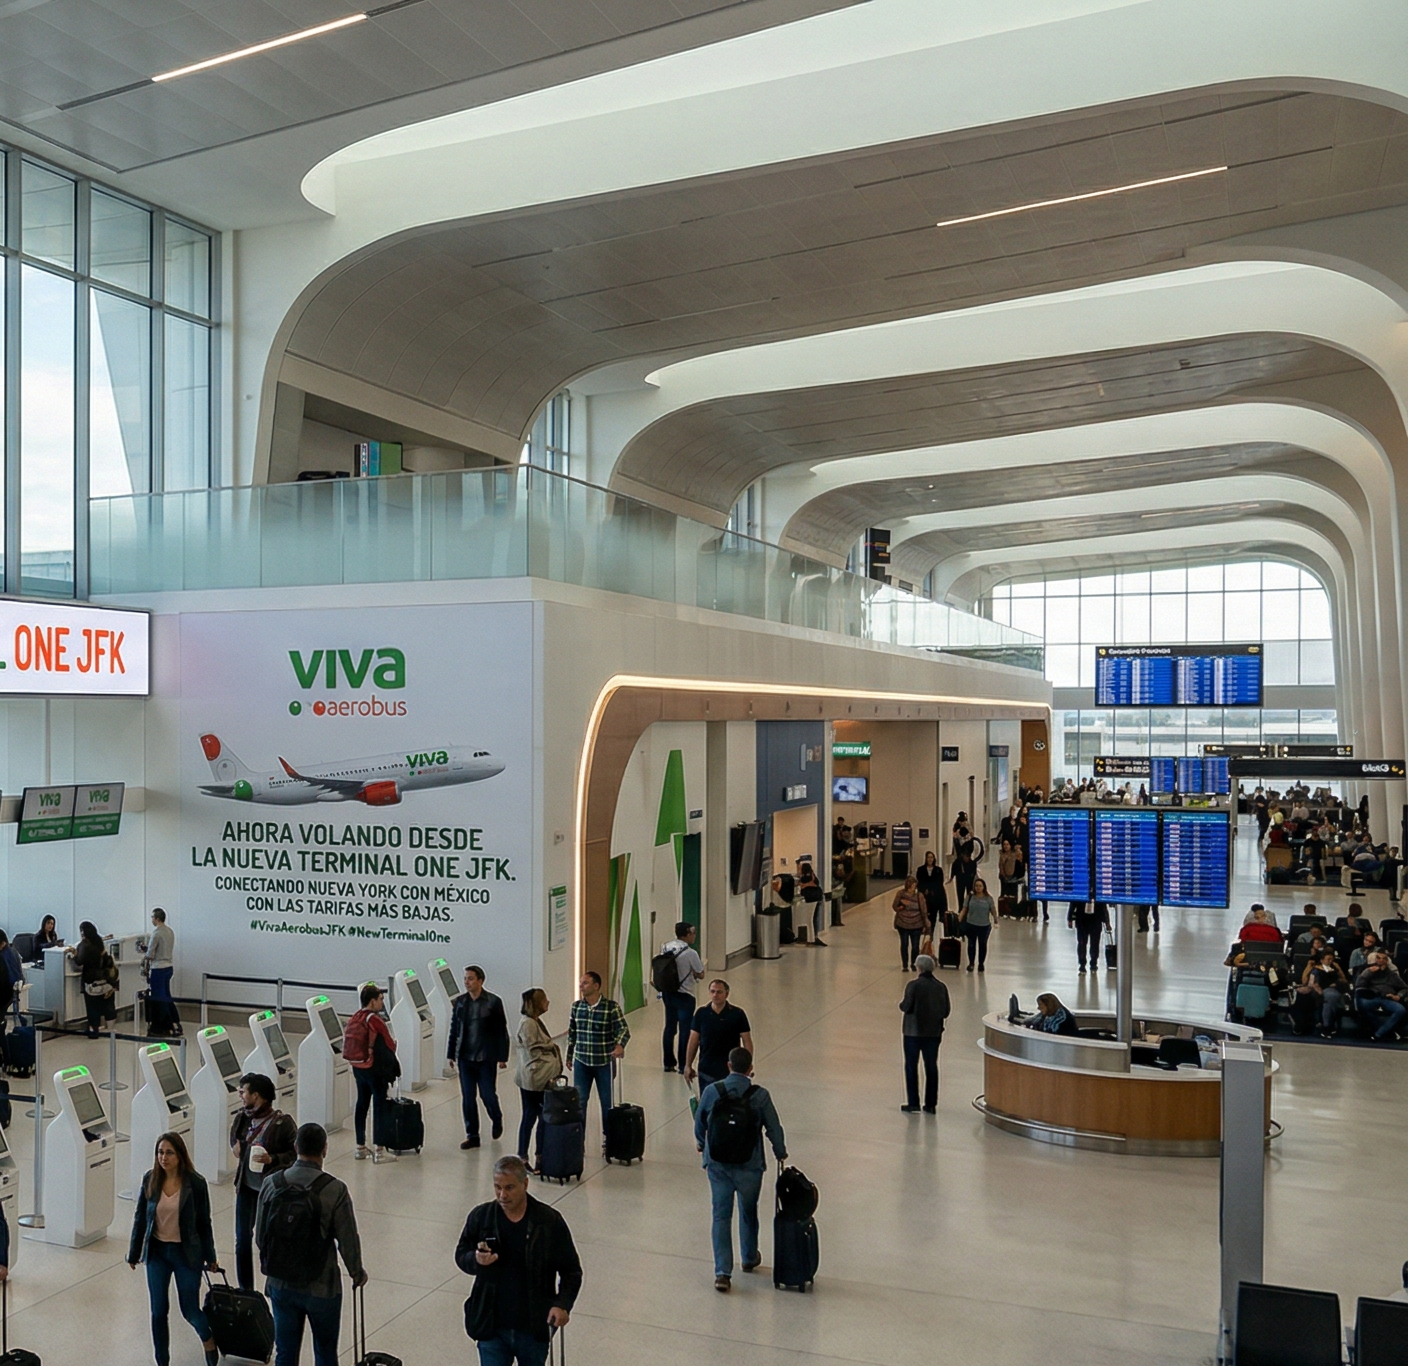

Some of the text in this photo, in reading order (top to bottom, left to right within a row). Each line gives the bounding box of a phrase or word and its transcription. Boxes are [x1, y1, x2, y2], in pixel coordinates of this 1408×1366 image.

[14, 624, 71, 673] ONE
[76, 628, 127, 675] JFK
[326, 695, 408, 717] aerobus
[222, 821, 484, 851] AHORA VOLANDO DESDE
[192, 846, 517, 882] LA NUEVA TERMINAL ONE JFK.
[215, 875, 491, 904] CONECTANDO NUEVA YORK CON MÉXICO
[246, 897, 455, 922] CON LAS TARIFAS MÁS BAJAS.
